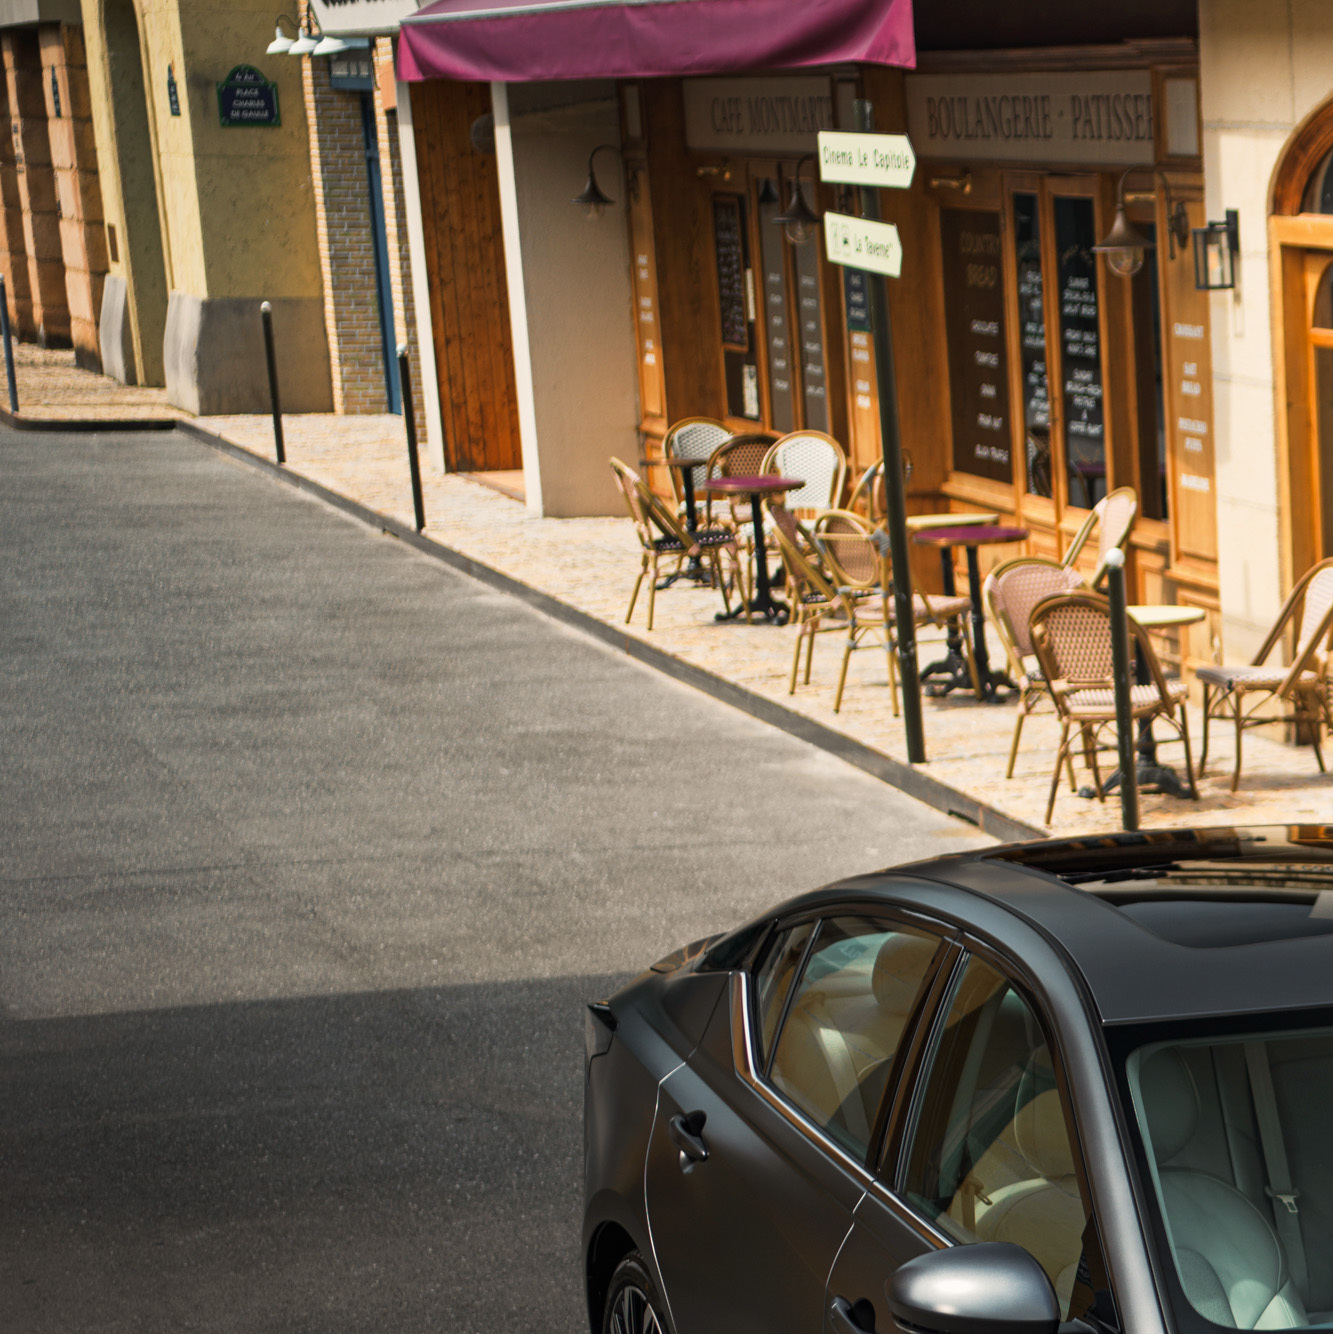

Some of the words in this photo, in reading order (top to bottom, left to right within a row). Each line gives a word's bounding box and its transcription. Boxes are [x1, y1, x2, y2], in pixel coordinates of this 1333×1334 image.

[926, 94, 1053, 141] BOULANGERIE
[823, 146, 853, 166] Cinema
[857, 147, 869, 168] Le
[874, 148, 910, 172] Capitole
